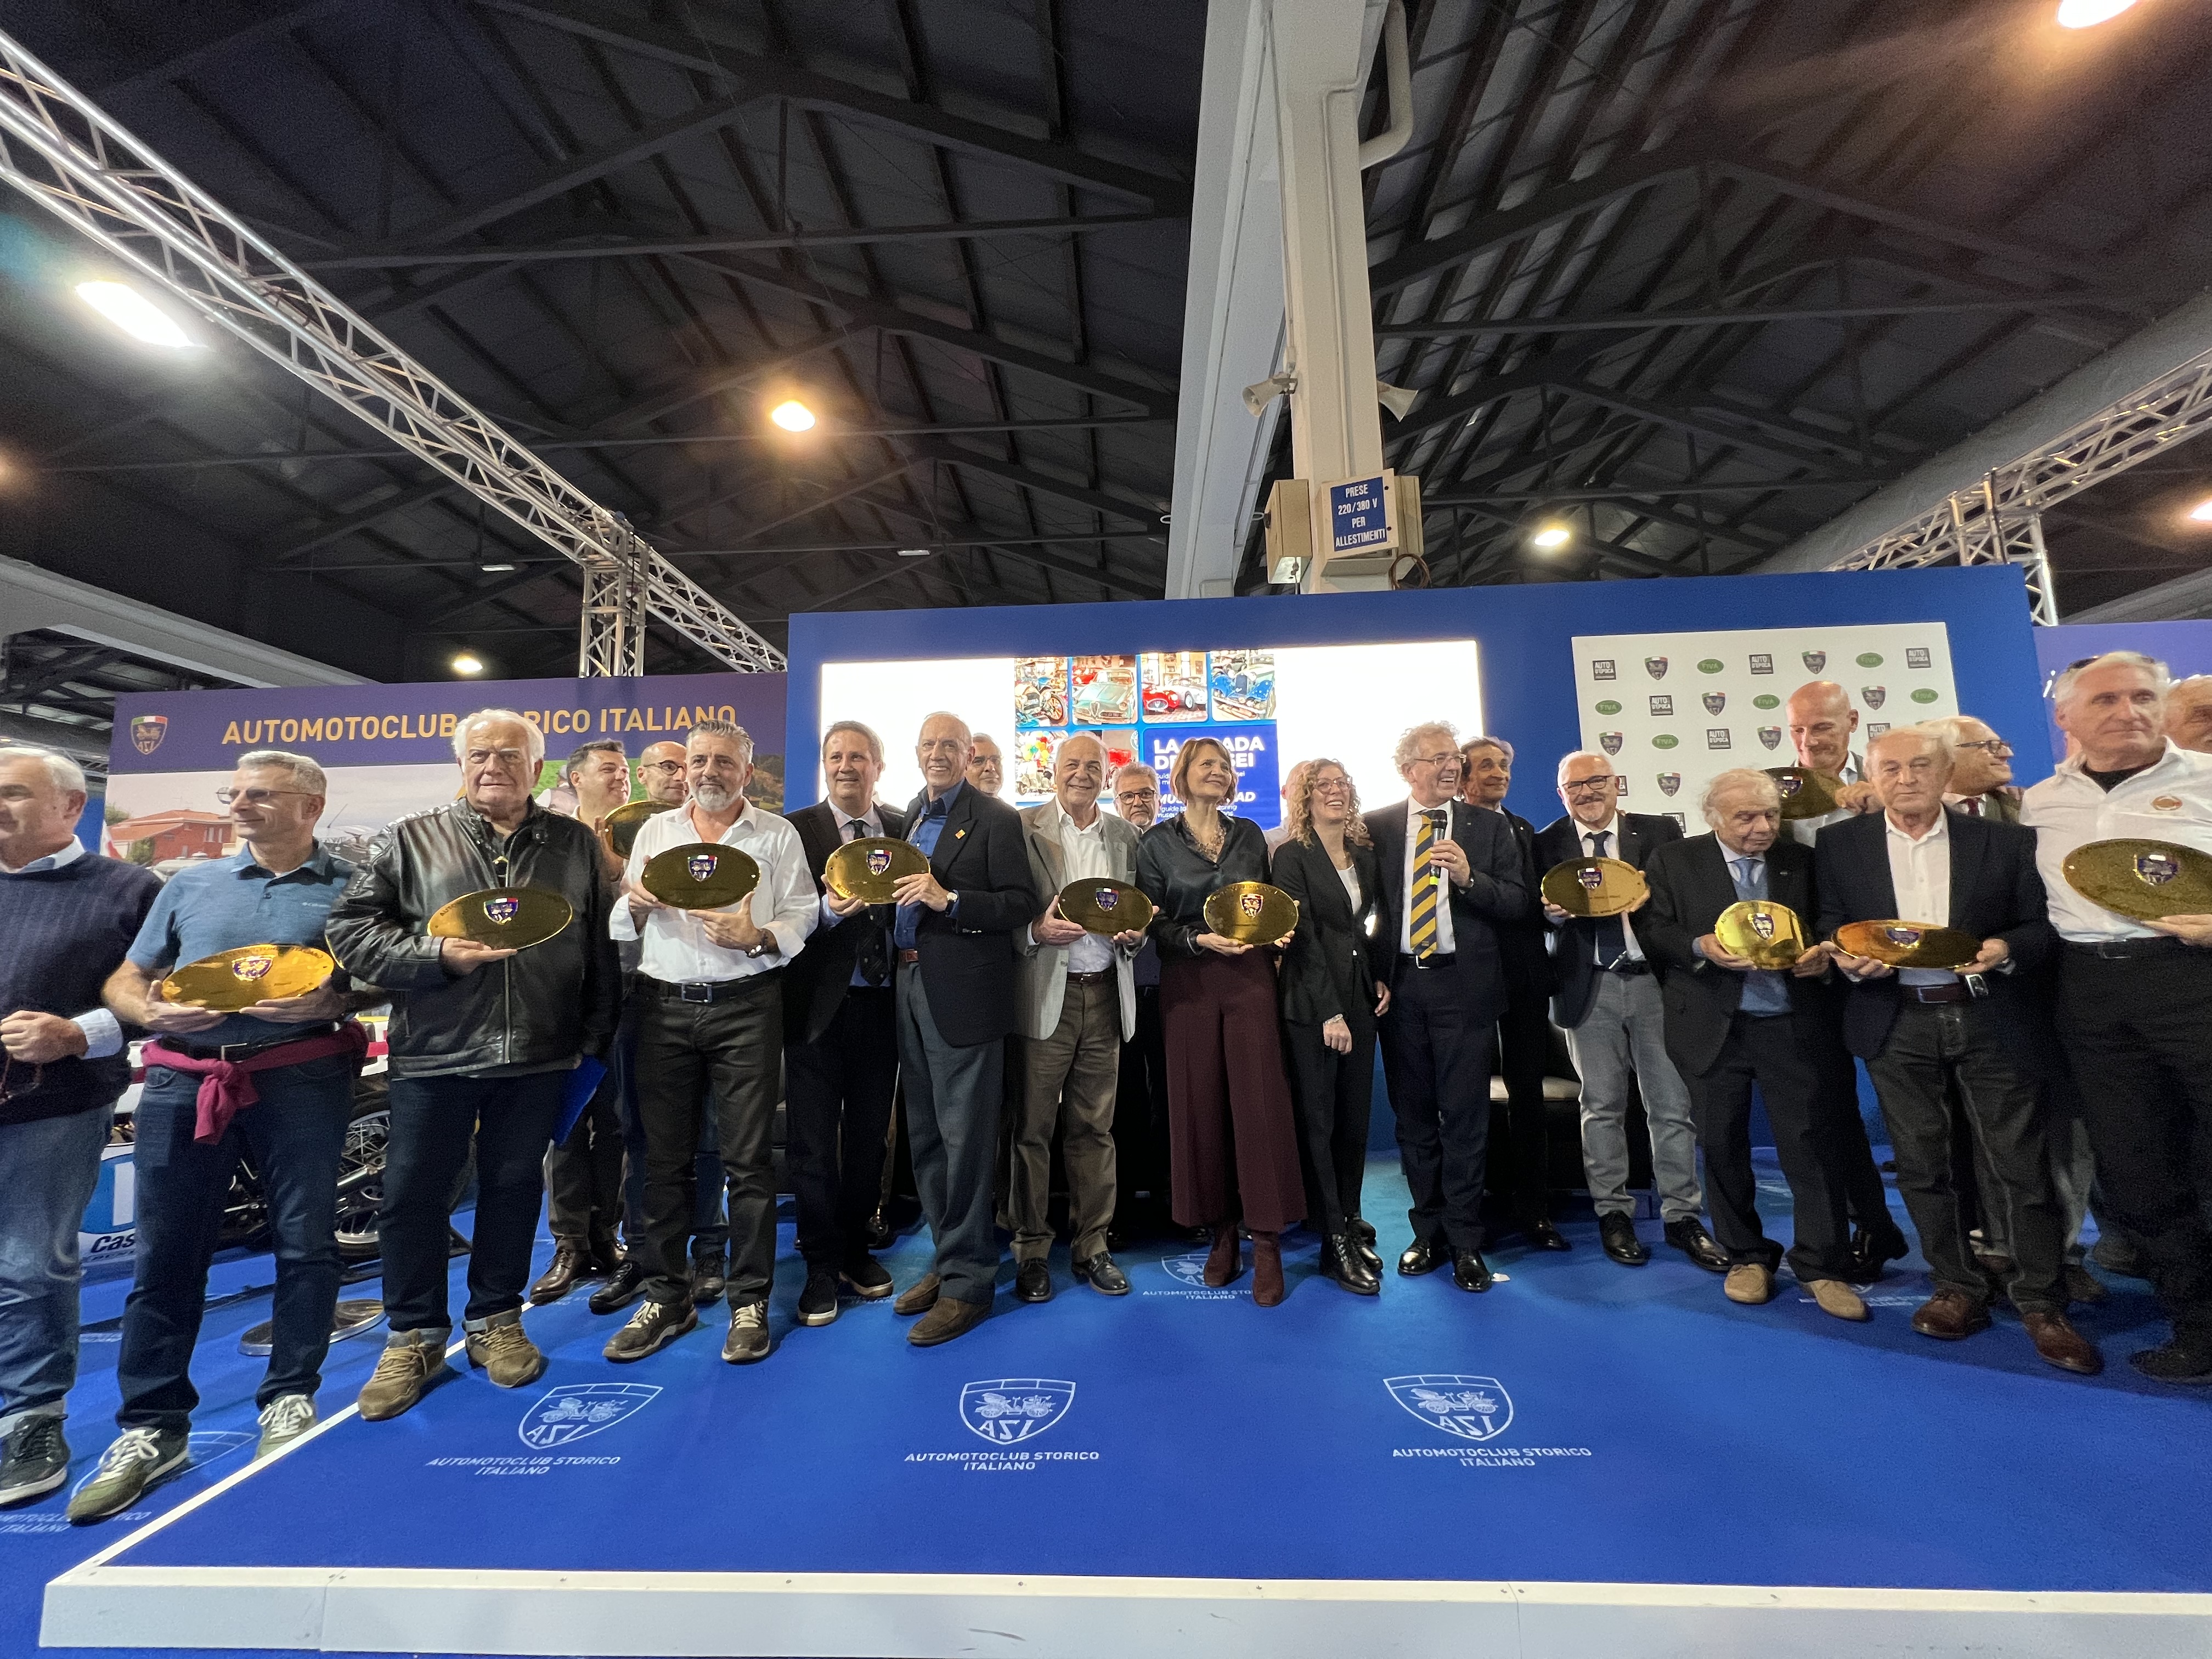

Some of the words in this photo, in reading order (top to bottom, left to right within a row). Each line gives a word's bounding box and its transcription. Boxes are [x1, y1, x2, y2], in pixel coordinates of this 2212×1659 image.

[1345, 484, 1369, 498] PRESE
[1338, 500, 1370, 515] 220/380
[1372, 498, 1378, 508] V
[1352, 516, 1366, 528] PER
[1335, 528, 1385, 547] ALLESTIMENTI
[222, 714, 458, 744] AUTOMOTOCLUB
[524, 709, 590, 734] RICO
[1154, 739, 1180, 754] LA
[904, 1452, 1030, 1462] AUTOMOTOCLUB
[1034, 1452, 1100, 1460] STORICO
[1392, 1448, 1520, 1457] AUTOMOTOCLUB
[1522, 1448, 1592, 1457] STORICO
[425, 1457, 553, 1466] AUTOMOTOCLUB
[552, 1457, 621, 1465] STORICO
[963, 1462, 1036, 1471] ITALIANO
[1459, 1458, 1536, 1466] ITALIANO
[474, 1466, 550, 1476] ITALIANO
